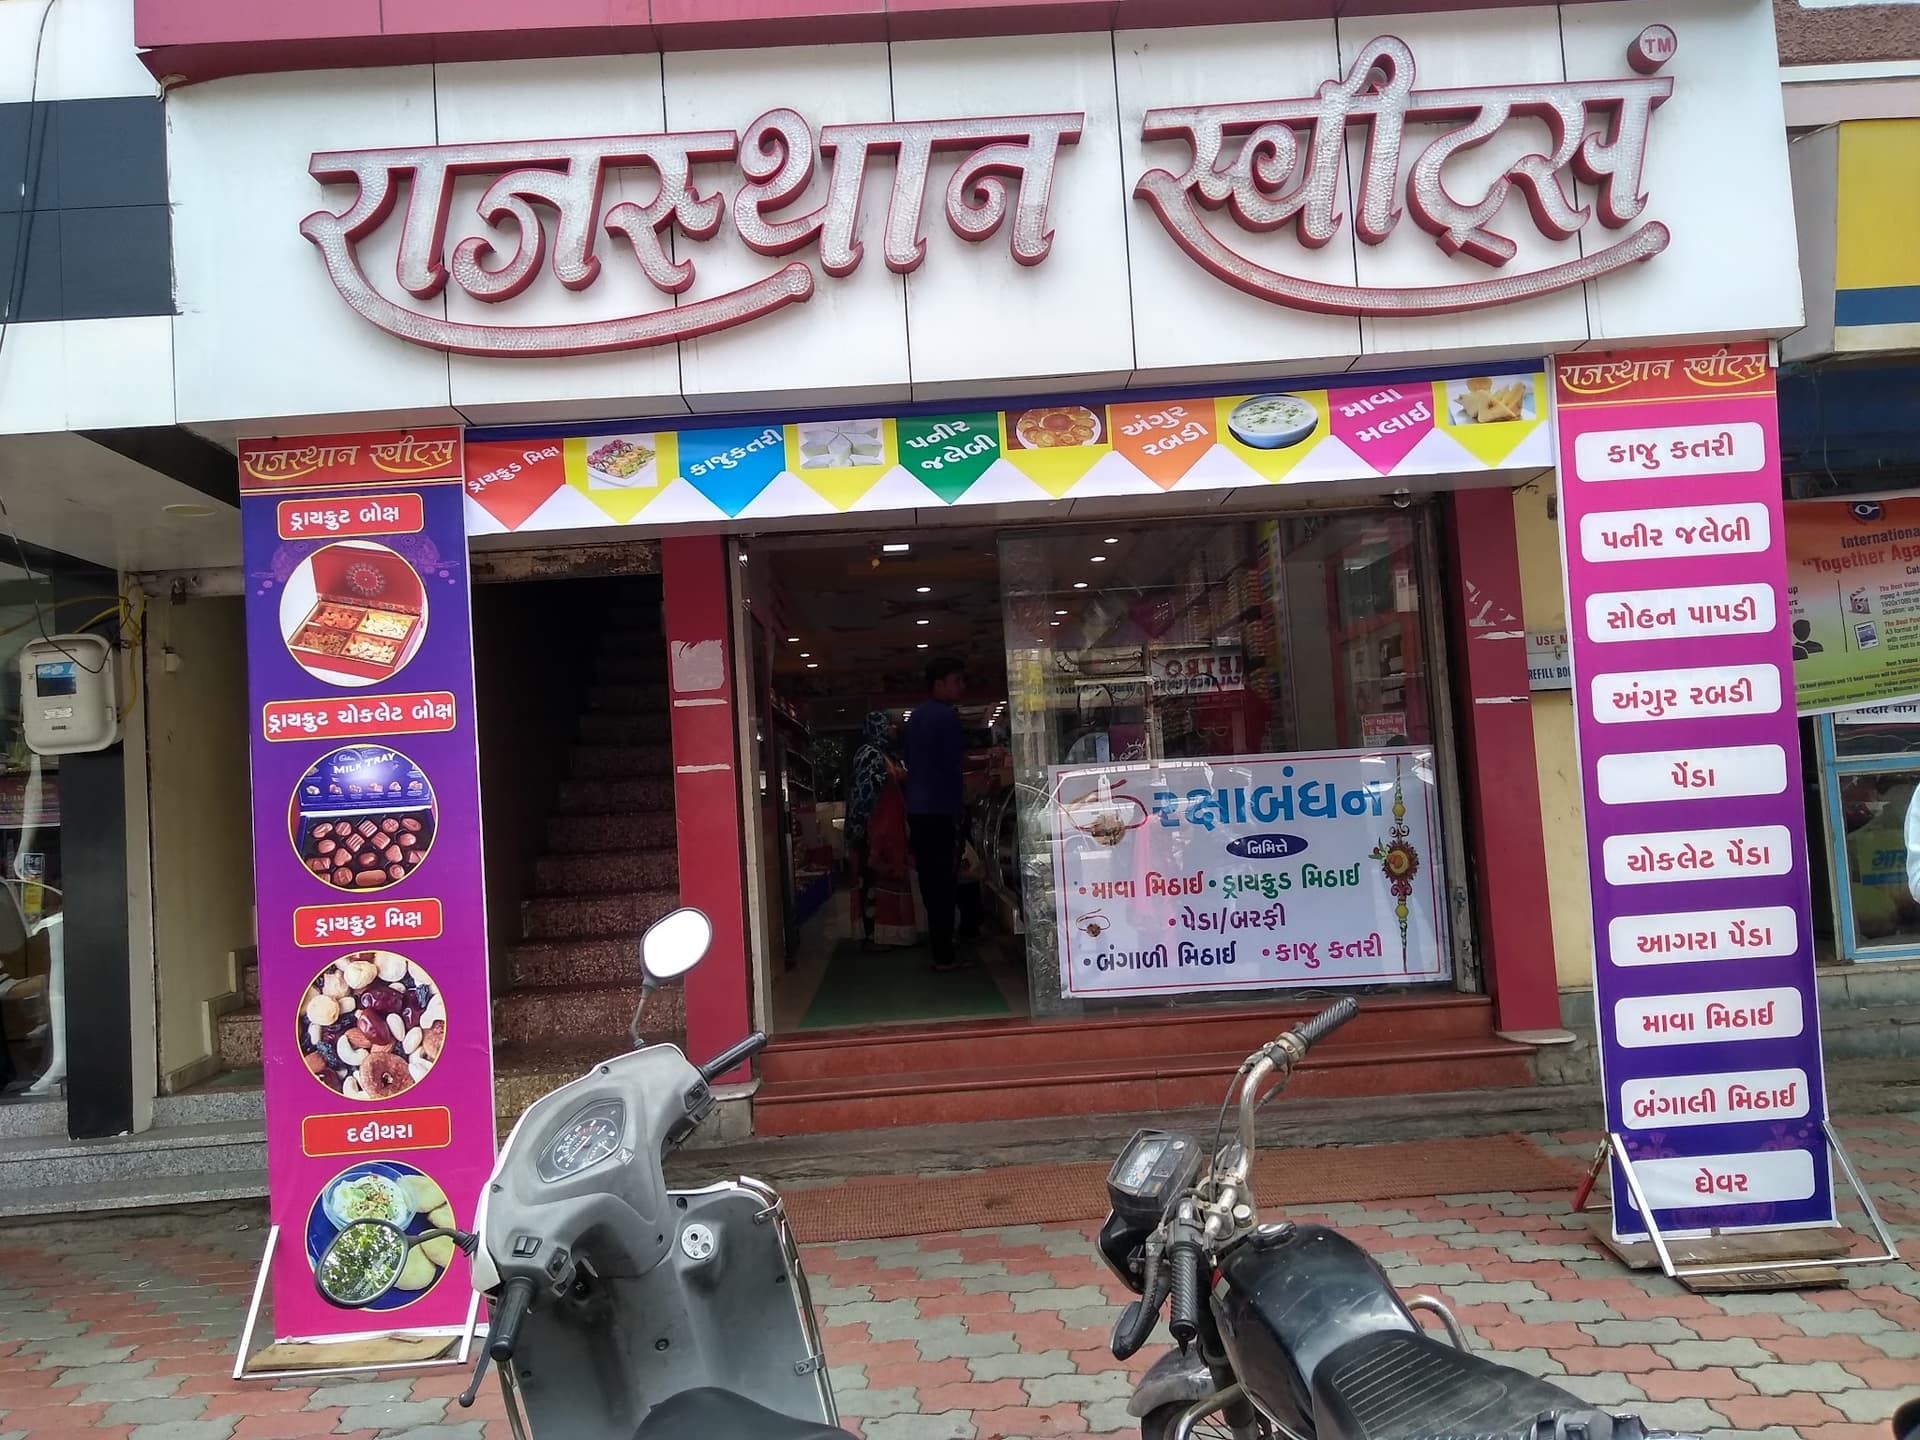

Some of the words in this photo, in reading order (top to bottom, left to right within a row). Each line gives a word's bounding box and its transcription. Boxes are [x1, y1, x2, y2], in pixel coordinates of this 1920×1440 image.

[1645, 36, 1673, 54] TM
[300, 108, 1085, 358] राजस्थान
[1133, 35, 1674, 317] स्वीट्स
[1559, 358, 1675, 394] राजस्थान
[1683, 348, 1767, 387] स्वीट्स
[1339, 388, 1403, 419] માવા
[906, 419, 970, 449] પનીર
[1120, 404, 1189, 438] અંગુર
[1355, 401, 1433, 442] મલાઈ
[690, 428, 784, 478] કાજુકતરી
[920, 432, 998, 471] જલેબી
[1141, 422, 1209, 457] રબડી
[1607, 442, 1660, 470] કાજુ
[1670, 431, 1734, 460] કતરી
[243, 444, 360, 480] राजस्थान
[369, 435, 457, 473] स्वीट्स
[359, 502, 400, 522] બોક્ષ
[1601, 522, 1663, 549] પનીર
[1675, 516, 1750, 545] જલેબી
[1607, 602, 1676, 629] સોહન
[1688, 596, 1757, 624] પાપડી
[1536, 635, 1556, 646] USE
[1528, 668, 1554, 681] REFILL
[337, 702, 403, 724] ચોકલેટ
[411, 699, 452, 720] બોક્ષ
[1612, 682, 1677, 717] અંગુર
[1690, 677, 1753, 705] રબડી
[333, 762, 362, 775] MILK
[365, 752, 396, 768] TRAY
[1671, 760, 1715, 788] પેંડા
[1151, 765, 1384, 833] રક્ષાબંધન
[1627, 843, 1715, 873] ચોકલેટ
[1726, 838, 1770, 866] પેંડા
[1091, 878, 1135, 900] માવા
[1145, 869, 1204, 898] મિઠાઈ
[1301, 862, 1361, 889] મિઠાઈ
[385, 907, 422, 928] મિક્ષ
[1096, 944, 1168, 973] બંગાળી
[1177, 940, 1236, 968] મિઠાઈ
[1274, 938, 1323, 969] કાજુ
[1328, 933, 1383, 960] કતરી
[1637, 931, 1717, 953] આગરા
[1728, 920, 1772, 947] પેંડા
[1642, 1012, 1694, 1033] માવા
[1705, 1001, 1775, 1029] મિઠાઈ
[1634, 1088, 1716, 1118] બંગાલી
[1728, 1083, 1796, 1111] મિઠાઈ
[346, 1121, 413, 1143] દહીથરા
[1695, 1168, 1748, 1193] ઘેવર
